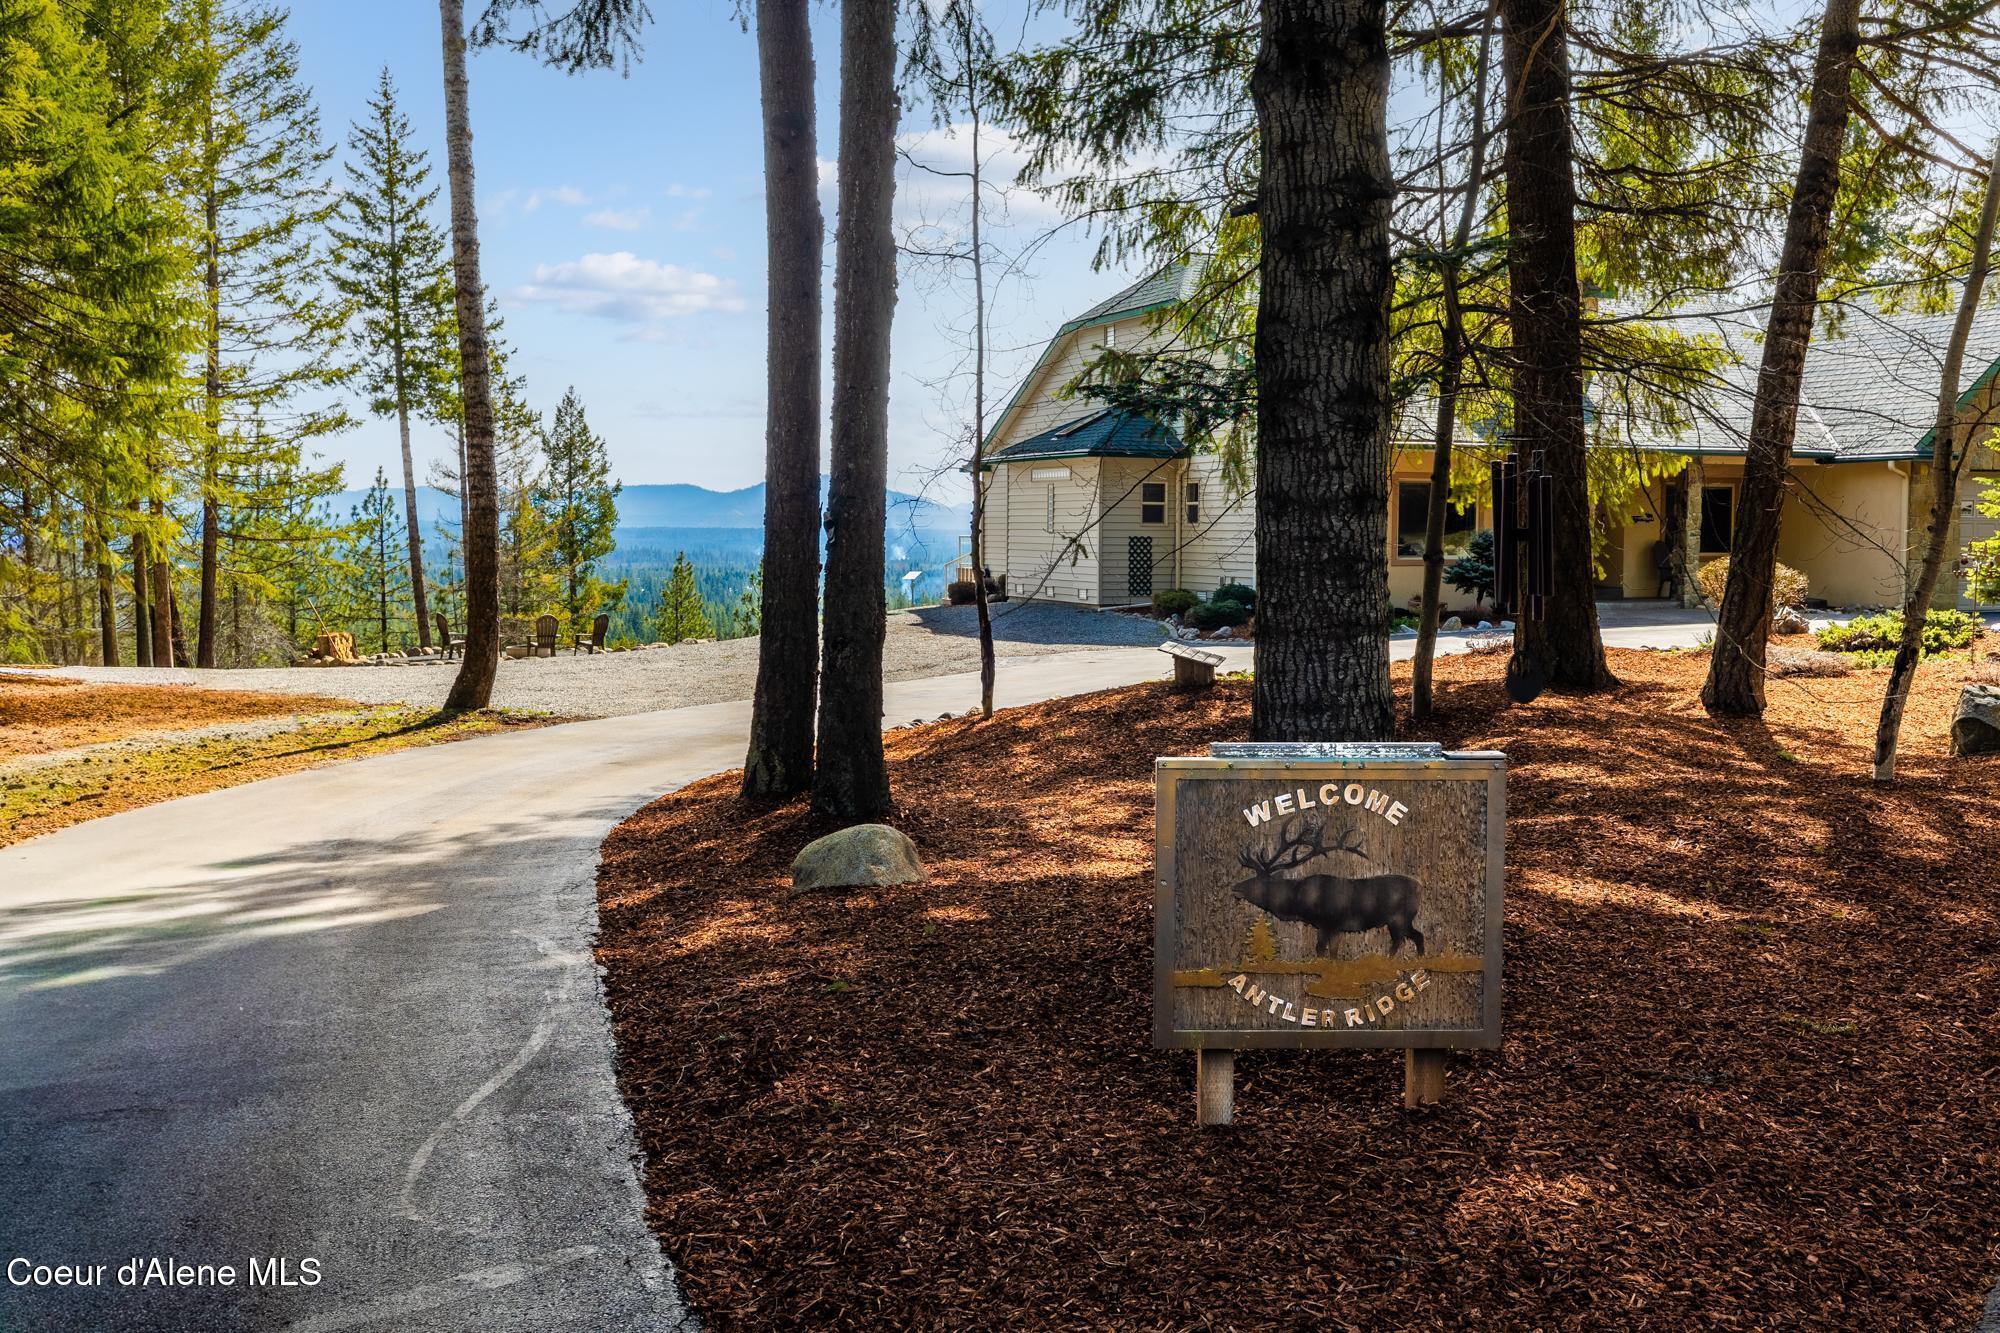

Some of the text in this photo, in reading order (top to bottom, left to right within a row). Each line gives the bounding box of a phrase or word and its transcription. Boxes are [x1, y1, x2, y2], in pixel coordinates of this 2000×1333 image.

[1243, 783, 1409, 828] WELCOME
[1228, 969, 1431, 1028] ANTLER RIDGE
